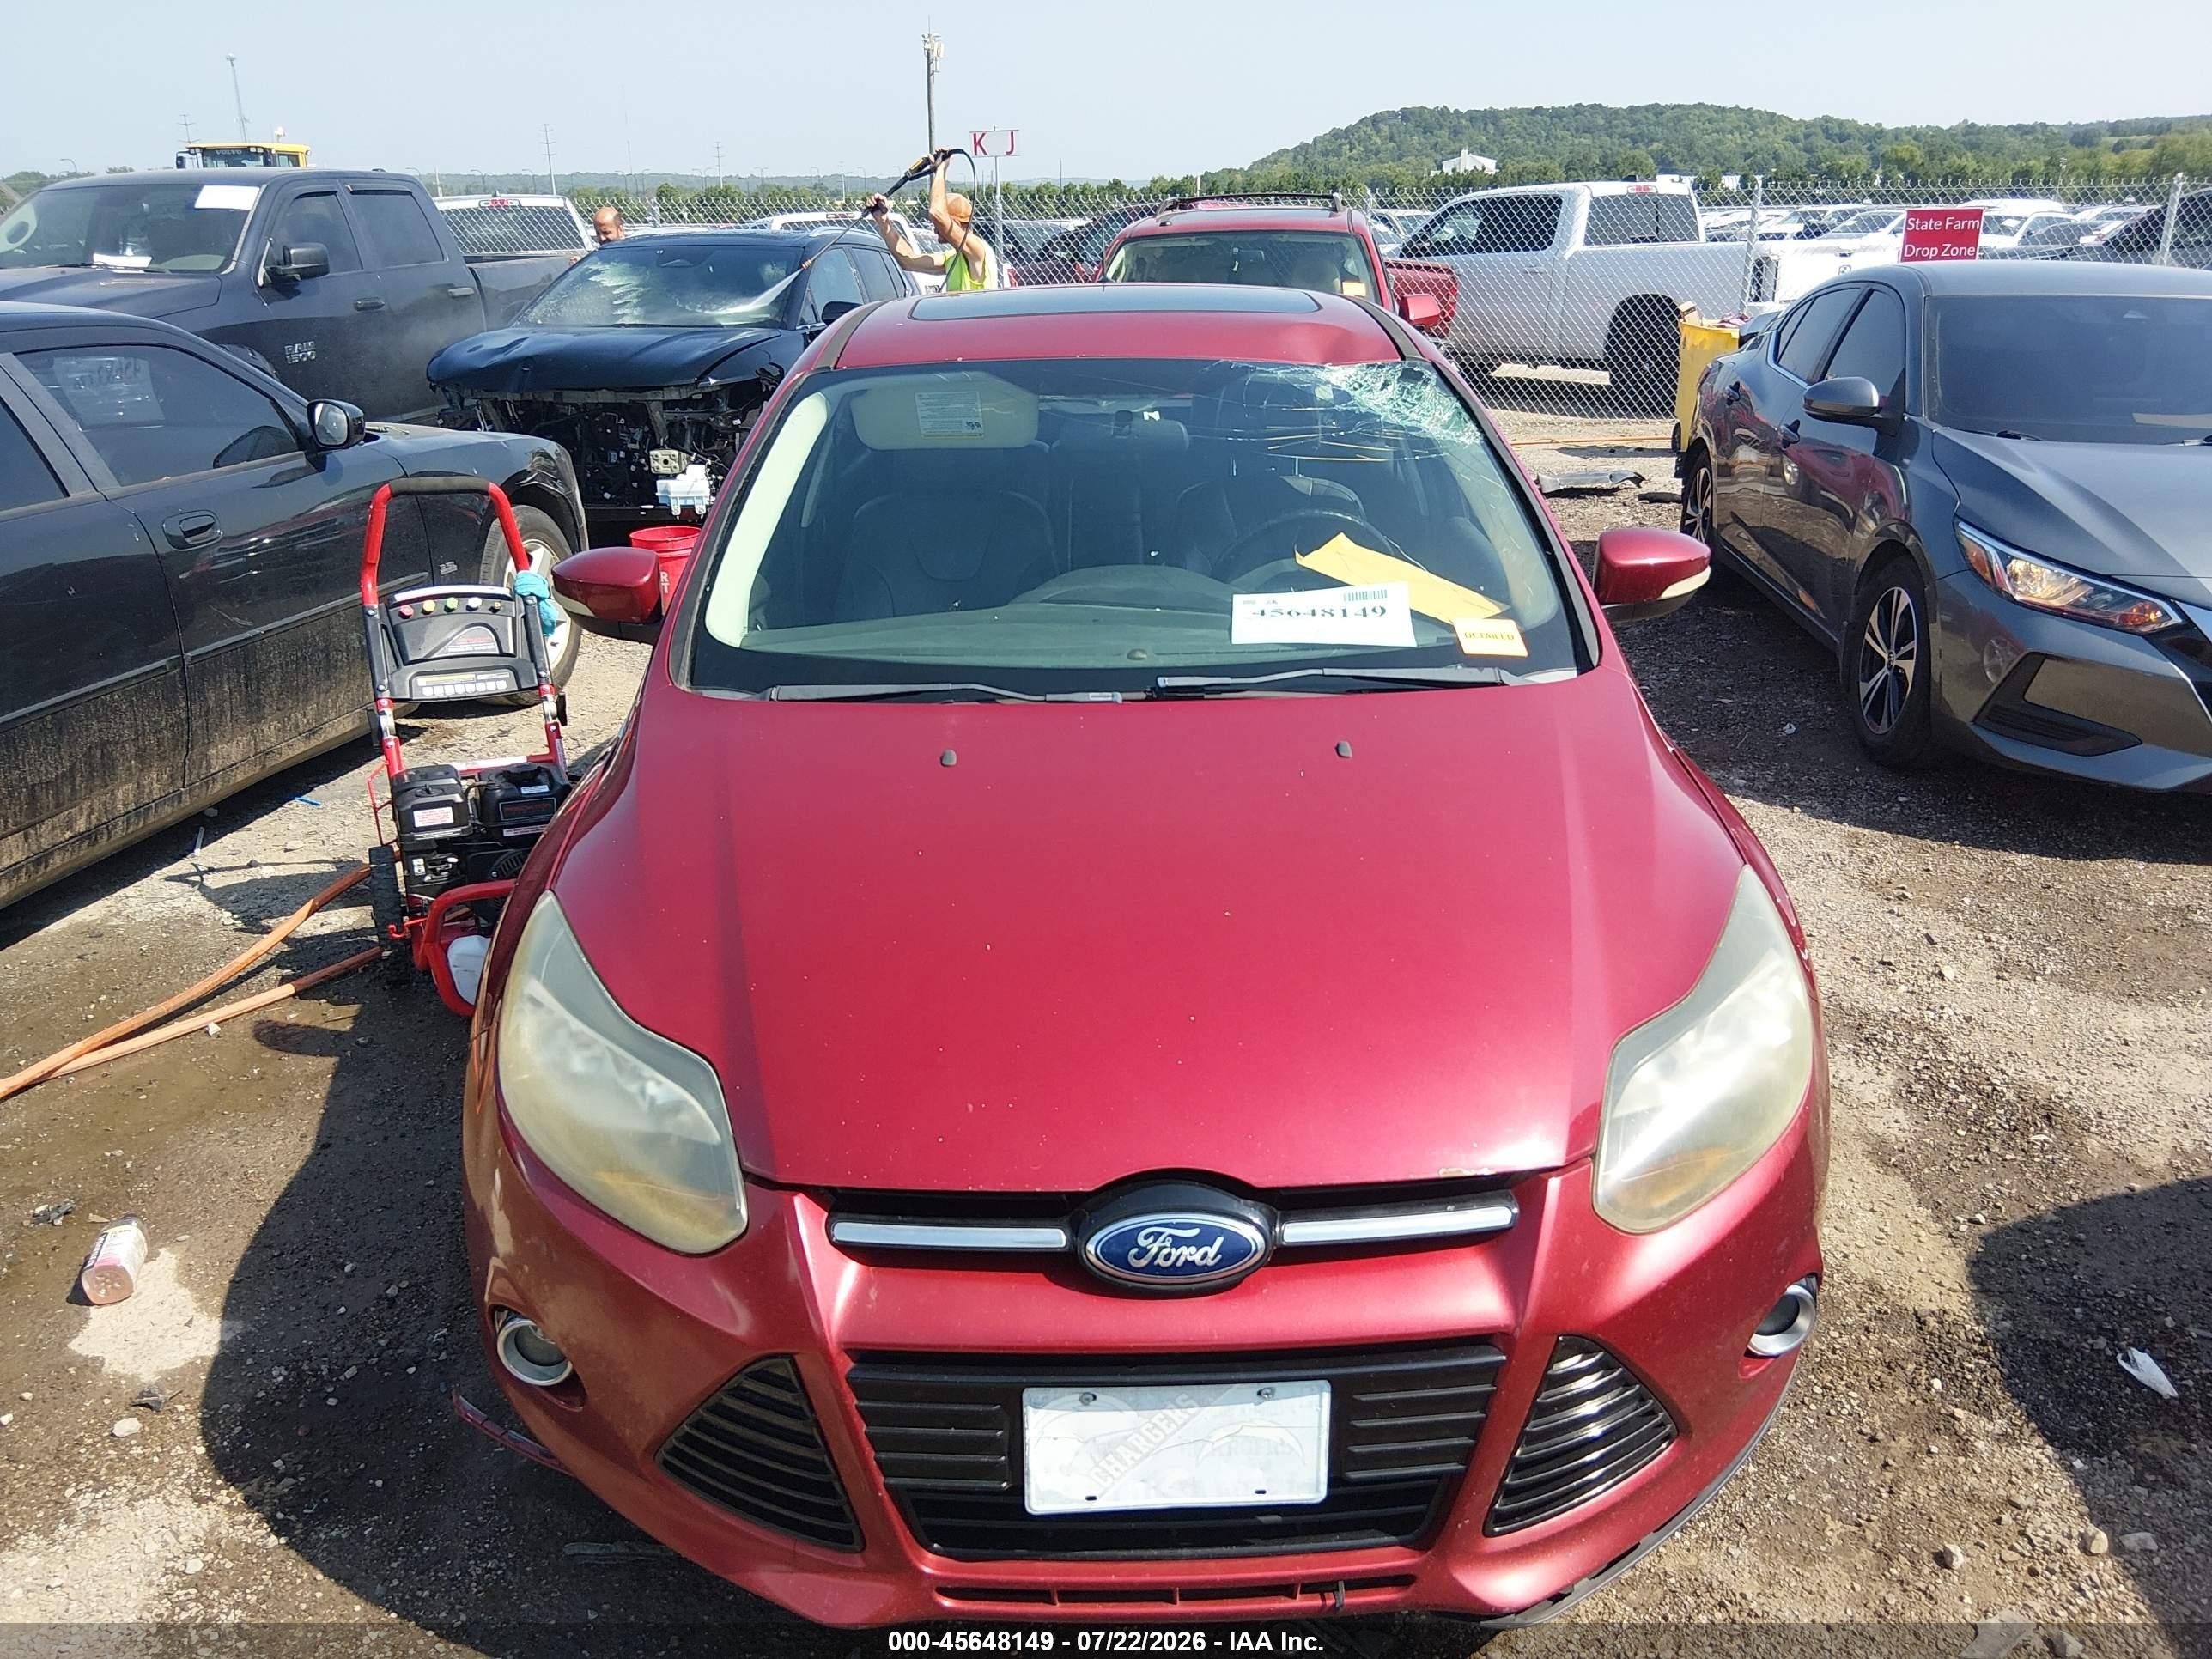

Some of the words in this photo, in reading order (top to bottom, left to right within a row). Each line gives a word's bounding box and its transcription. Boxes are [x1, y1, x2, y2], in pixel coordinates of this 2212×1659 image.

[973, 133, 988, 155] K
[1006, 131, 1014, 155] J
[1906, 217, 1942, 231] State
[1945, 216, 1980, 230] Farm
[1904, 244, 1938, 259] Drop
[1942, 244, 1975, 257] Zone
[284, 341, 316, 355] RAM
[286, 351, 316, 364] 1500
[1252, 605, 1387, 618] 45648149
[1128, 1226, 1224, 1267] Ford
[1091, 1393, 1201, 1487] CHARGERS
